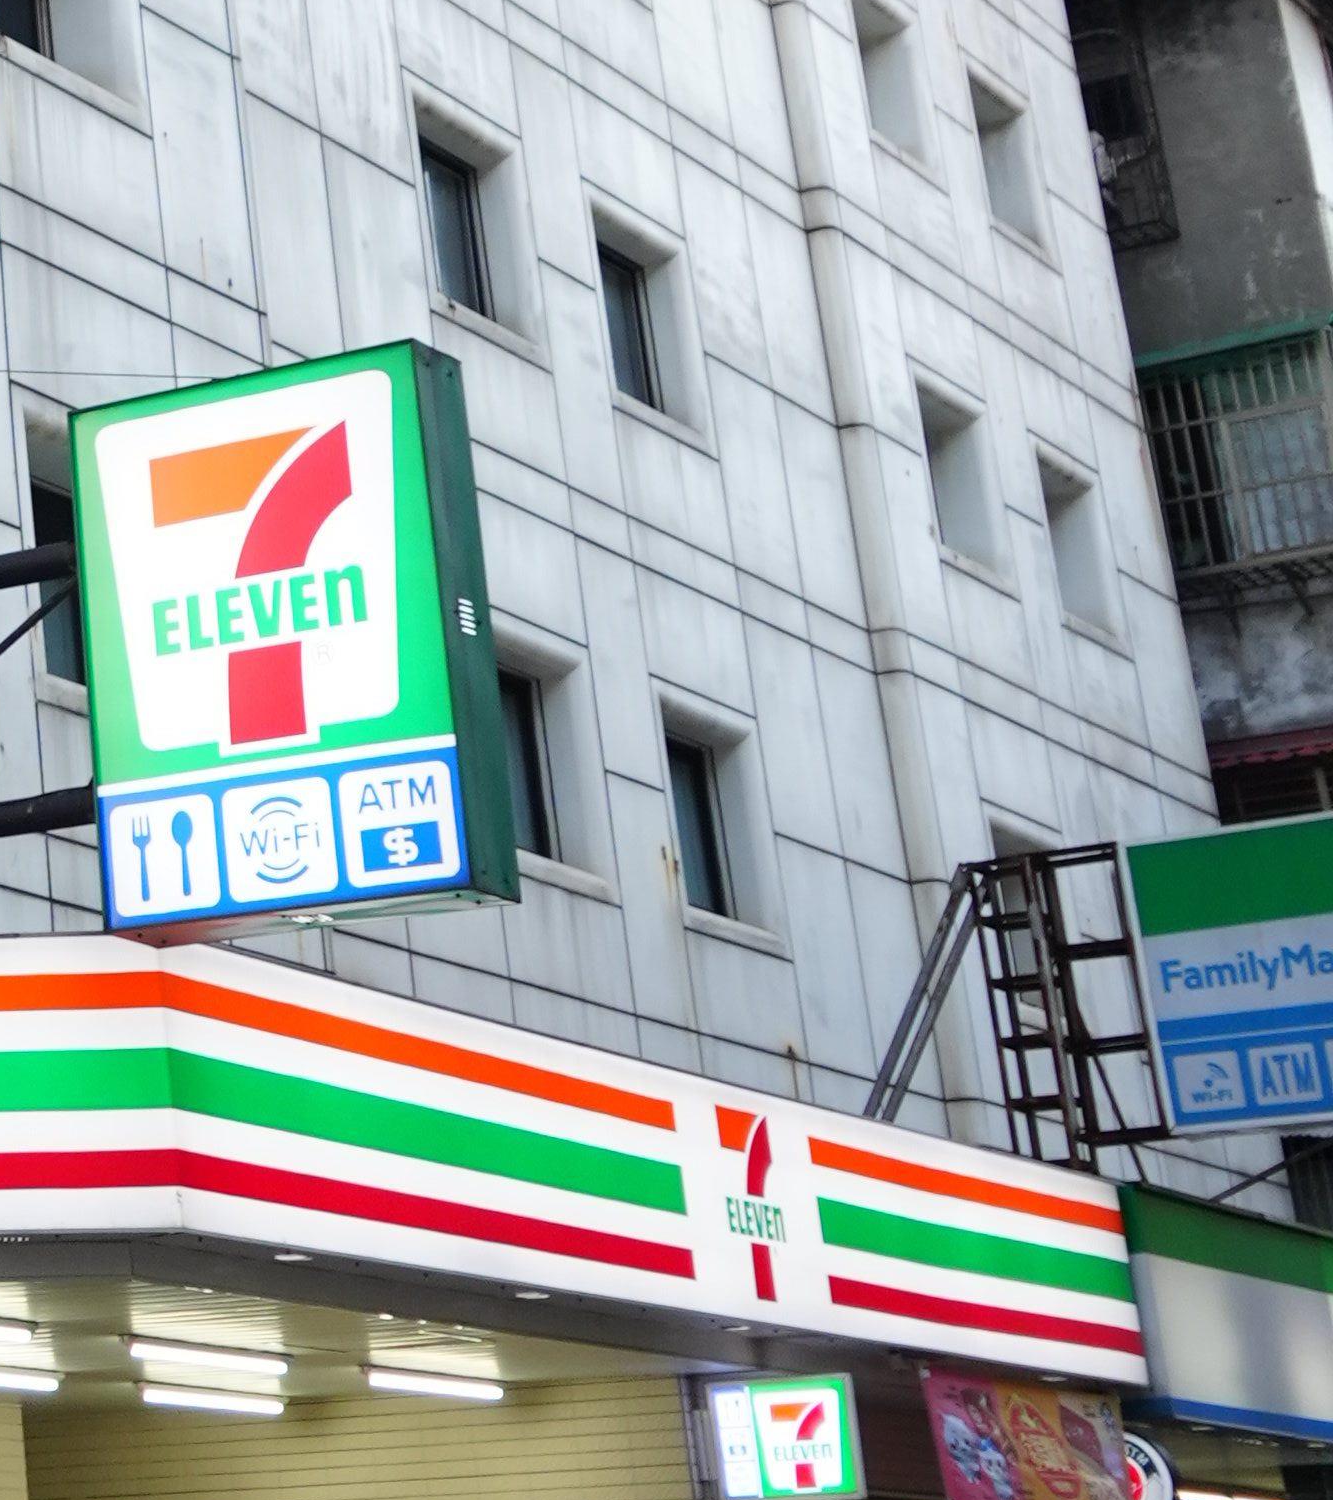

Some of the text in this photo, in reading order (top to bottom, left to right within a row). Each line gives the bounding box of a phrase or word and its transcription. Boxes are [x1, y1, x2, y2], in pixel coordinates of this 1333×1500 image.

[357, 775, 437, 816] ATM
[239, 820, 322, 859] Wi-Fi
[1259, 1051, 1316, 1098] ATM
